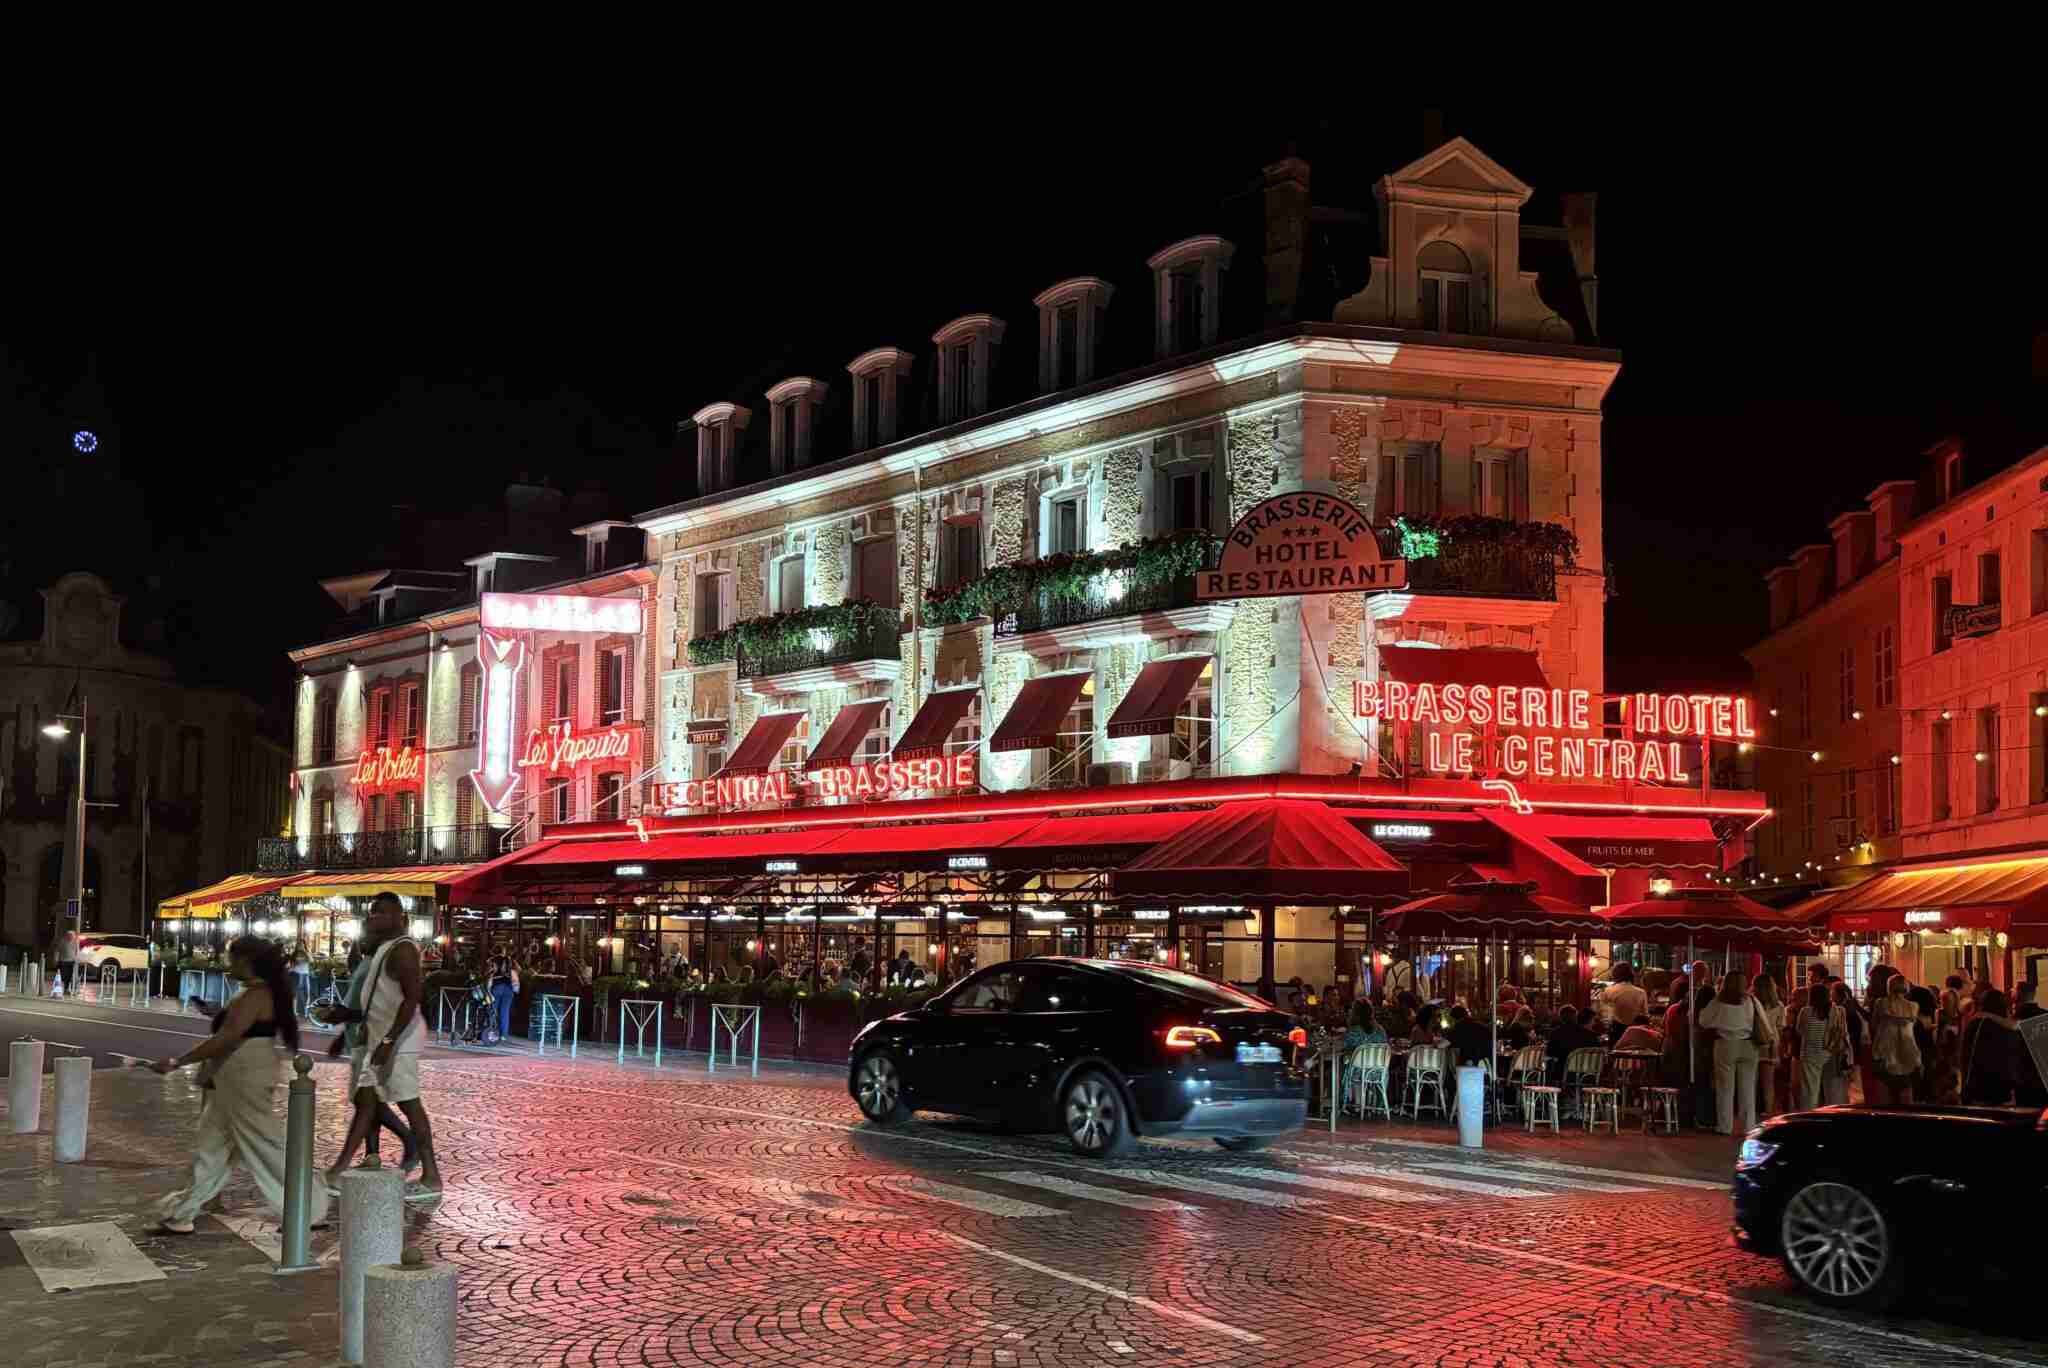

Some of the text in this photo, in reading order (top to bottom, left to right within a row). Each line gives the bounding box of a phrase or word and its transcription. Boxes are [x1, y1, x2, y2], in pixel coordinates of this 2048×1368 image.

[1232, 497, 1367, 549] BRASSERIE
[1255, 540, 1348, 565] HOTEL
[1208, 563, 1395, 593] RESTAURANT
[1353, 680, 1757, 738] BRASSERIE HOTEL
[350, 746, 420, 786] Les Voiles
[518, 722, 630, 772] Les Vapeurs
[1427, 732, 1689, 782] LE CENTRAL
[651, 783, 677, 809] LE
[686, 771, 797, 806] CENTRAL
[819, 754, 974, 797] BRASSERIE
[1373, 825, 1433, 838] LE CENTRAL
[1586, 845, 1655, 857] FRUITS DE MER
